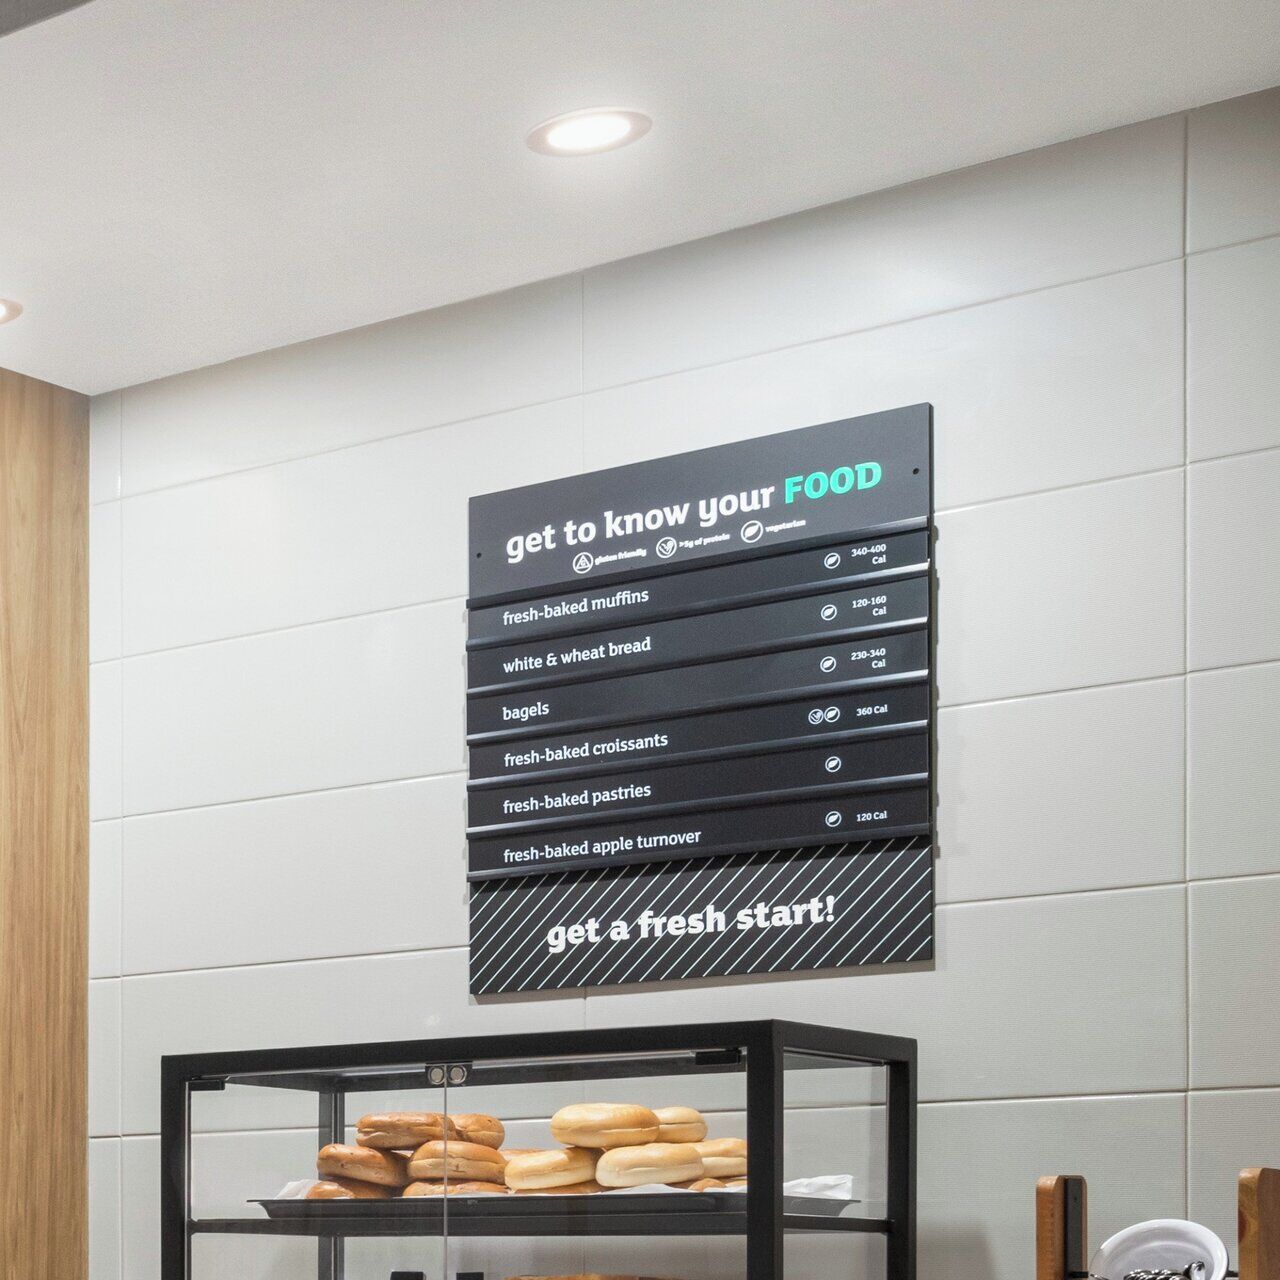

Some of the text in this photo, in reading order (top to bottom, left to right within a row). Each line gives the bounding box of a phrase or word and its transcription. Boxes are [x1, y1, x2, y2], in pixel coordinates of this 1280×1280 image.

[506, 461, 883, 563] get to know your FOOD
[851, 544, 887, 557] 340-400
[872, 555, 887, 565] Cal
[503, 590, 649, 625] fresh-baked muffins
[852, 595, 887, 608] 120-160
[872, 606, 887, 616] Cal
[503, 636, 651, 674] white & wheat bread
[851, 648, 886, 661] 230-340
[872, 659, 886, 669] Cal
[502, 701, 549, 721] bagels
[856, 704, 888, 717] 360 Cal
[504, 734, 668, 767] fresh-baked croissants
[503, 784, 651, 814] fresh-baked pastries
[856, 811, 887, 822] 120 Cal
[503, 830, 701, 863] fresh-baked apple turnover
[547, 895, 836, 953] get a fresh start!
